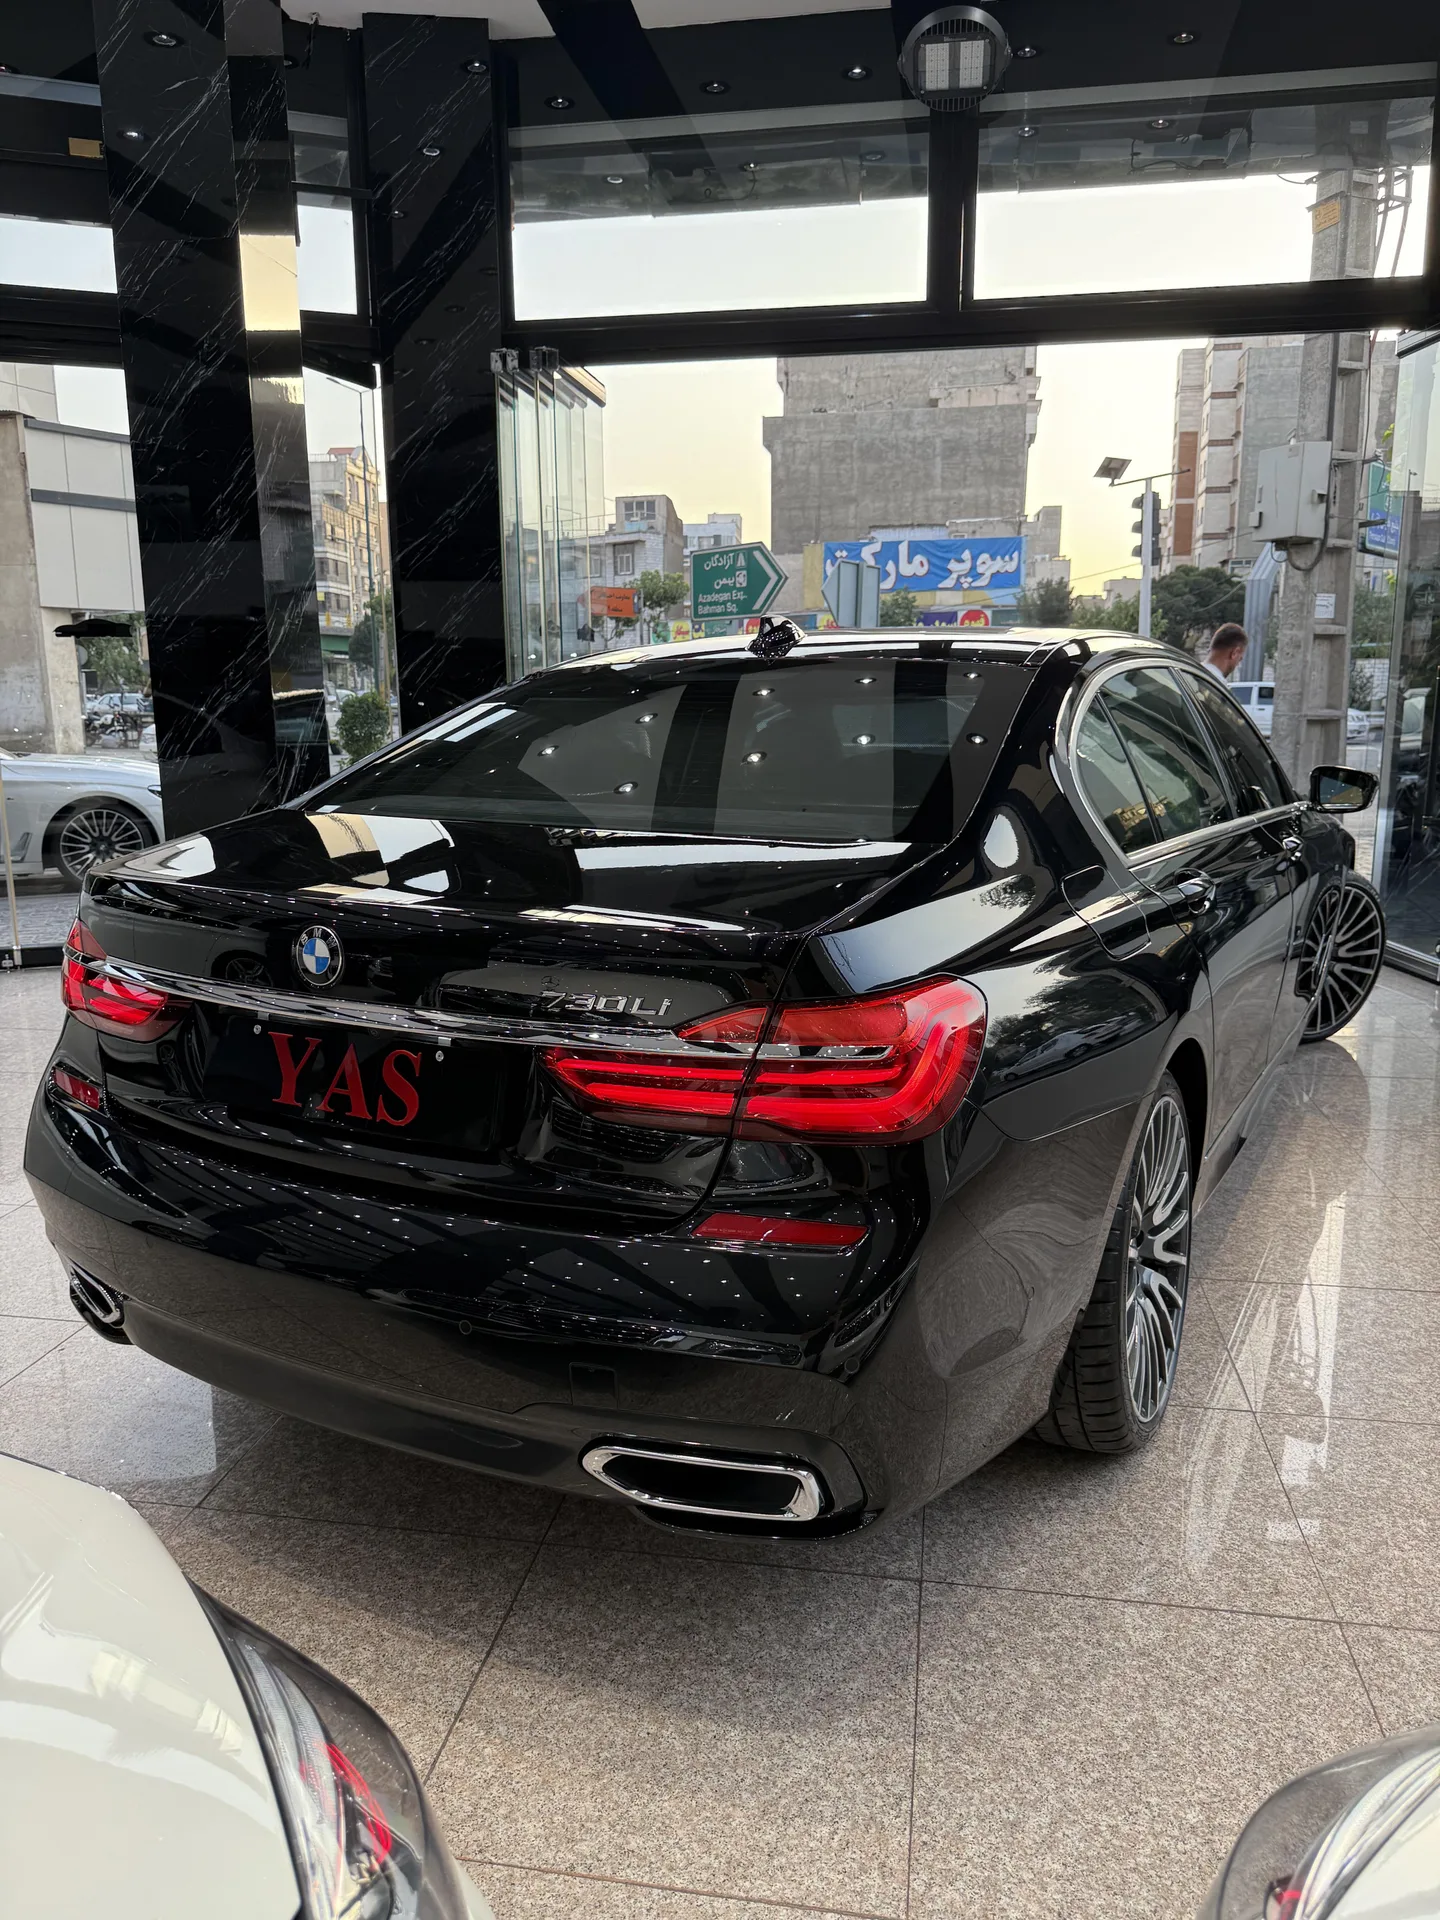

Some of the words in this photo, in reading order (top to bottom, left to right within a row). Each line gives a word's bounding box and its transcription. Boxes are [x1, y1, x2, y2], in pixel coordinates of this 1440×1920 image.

[703, 552, 735, 571] آزادگان
[937, 548, 1020, 589] سوپر
[697, 604, 725, 615] Bahman
[726, 602, 738, 614] Sq.
[698, 592, 731, 603] Azadegan
[300, 927, 338, 949] BMW
[540, 990, 674, 1016] 730Li
[267, 1030, 423, 1127] YAS
